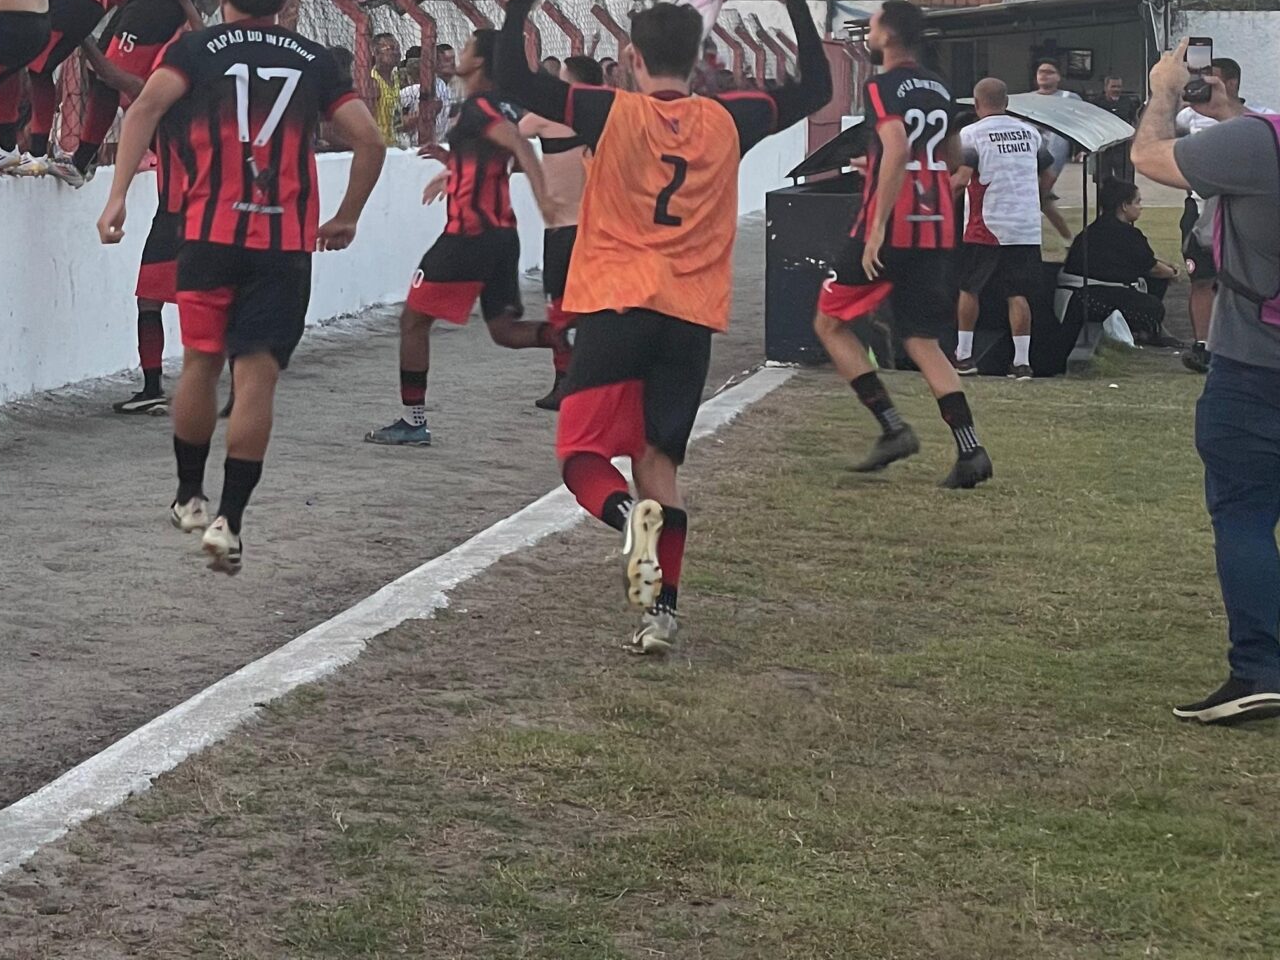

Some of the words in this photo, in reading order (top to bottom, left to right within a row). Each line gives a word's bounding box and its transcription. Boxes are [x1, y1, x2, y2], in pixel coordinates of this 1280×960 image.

[118, 31, 138, 53] 15
[224, 62, 303, 146] 17
[904, 108, 948, 171] 22
[653, 153, 688, 227] 2
